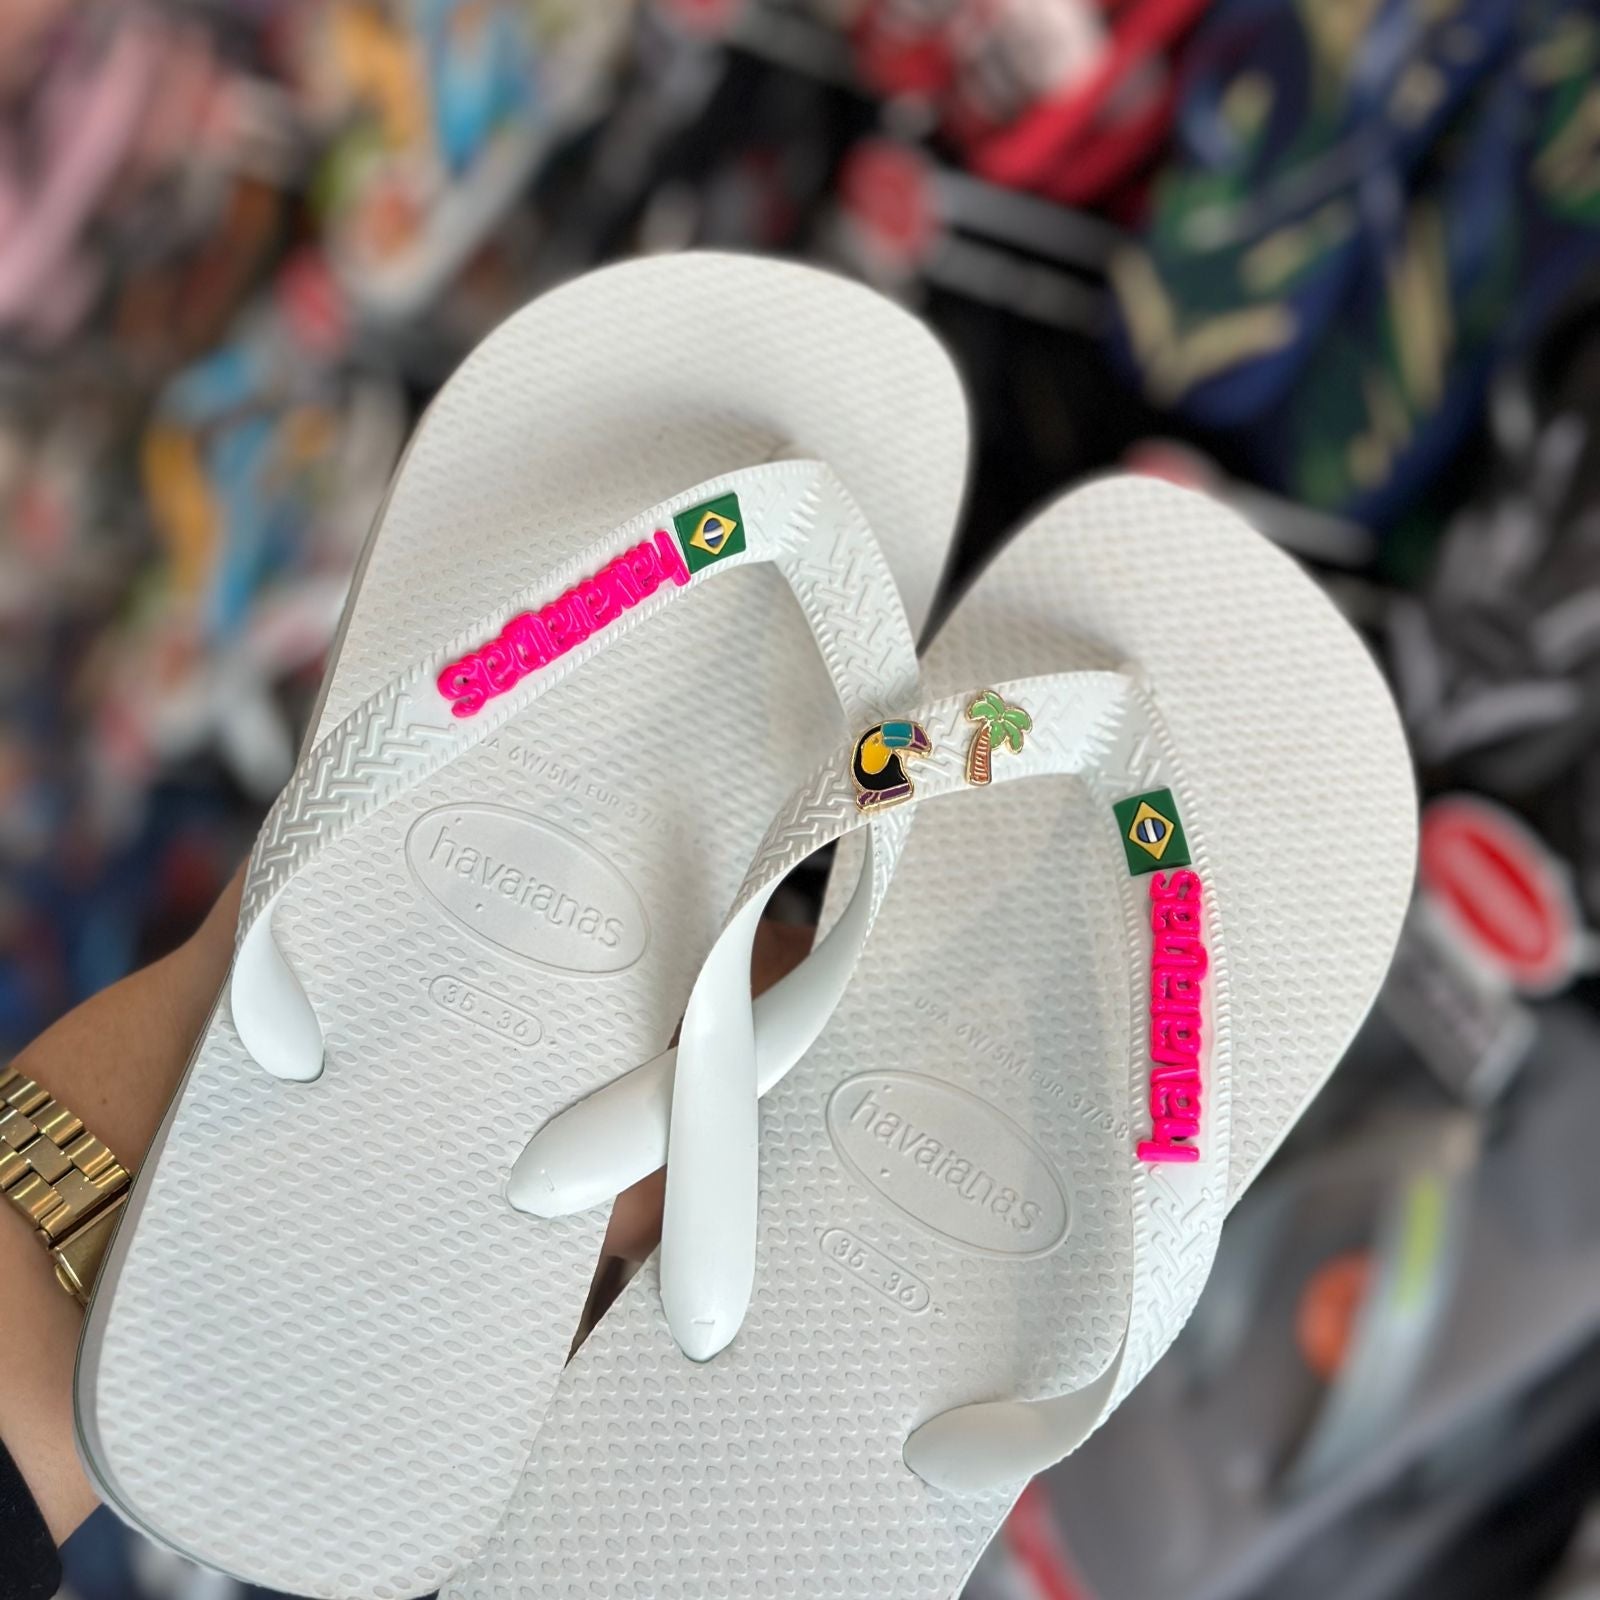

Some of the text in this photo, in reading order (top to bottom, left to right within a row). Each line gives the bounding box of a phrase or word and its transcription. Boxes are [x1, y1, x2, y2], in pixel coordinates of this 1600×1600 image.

[436, 530, 691, 717] havaianas
[585, 783, 621, 808] EUR
[624, 801, 677, 838] 37/3
[429, 825, 625, 948] havaianas
[1136, 869, 1209, 1162] havaianas
[850, 1090, 1042, 1232] havaianas
